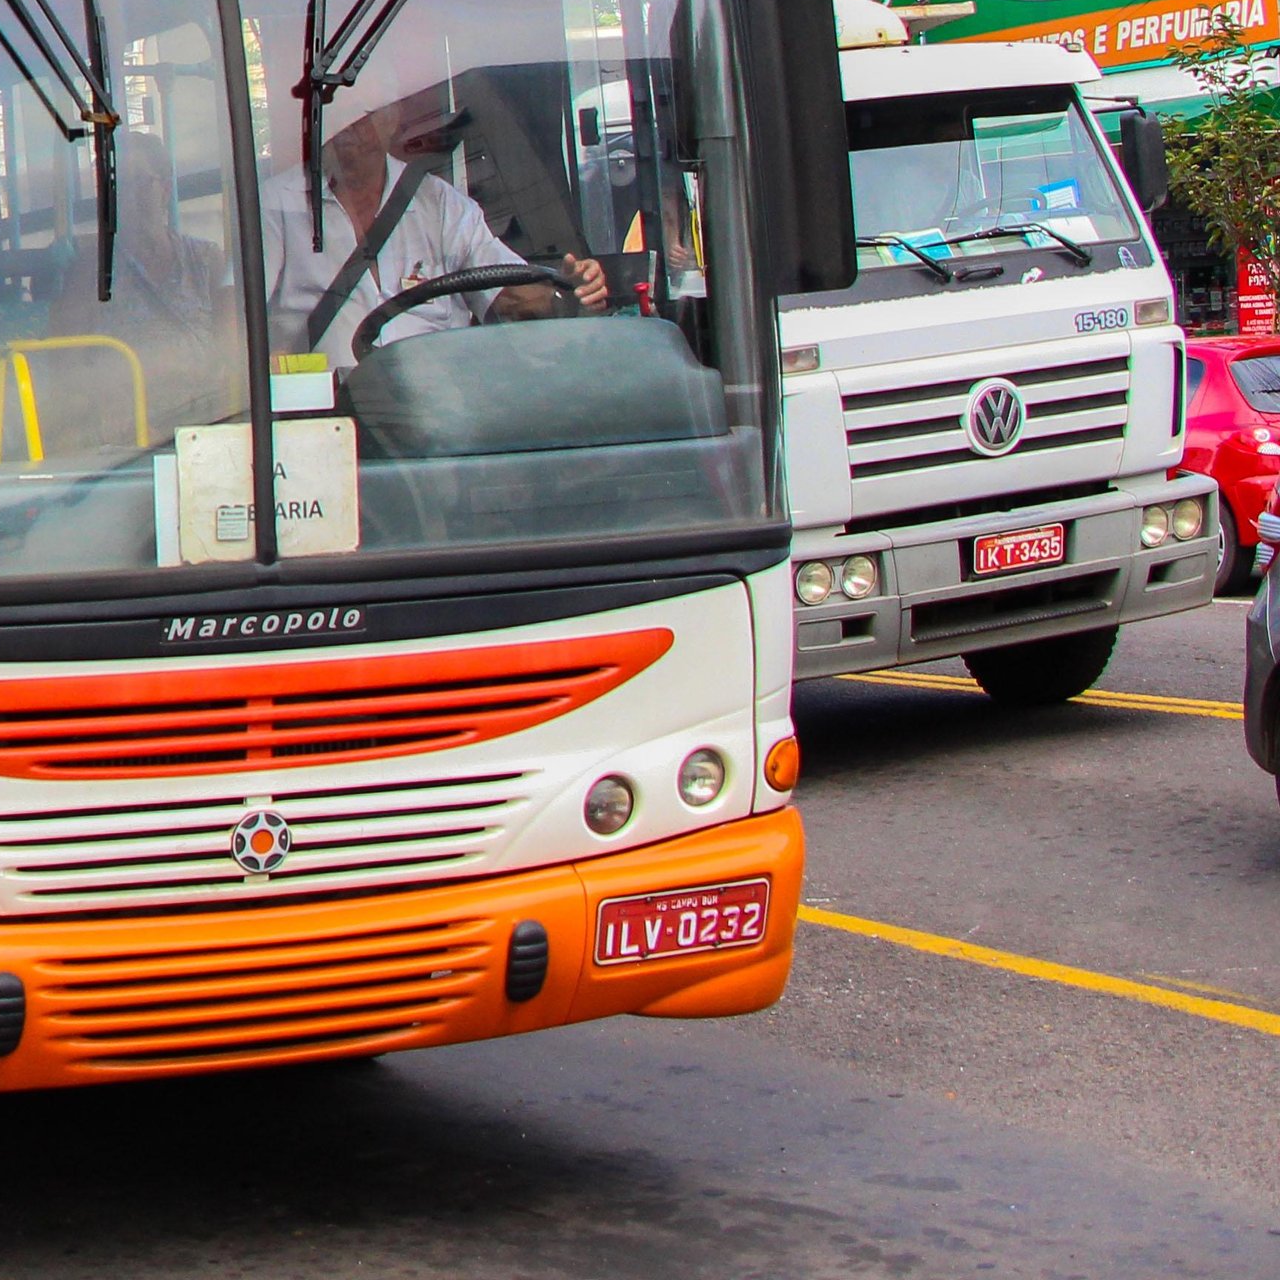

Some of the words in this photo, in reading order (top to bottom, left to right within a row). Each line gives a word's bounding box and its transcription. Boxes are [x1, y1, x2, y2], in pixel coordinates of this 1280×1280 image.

[1093, 24, 1108, 55] E
[1074, 307, 1129, 333] 15-180
[979, 536, 1061, 569] IKT-3435
[167, 608, 361, 641] Marcopolo
[605, 902, 761, 957] ILV-0232
